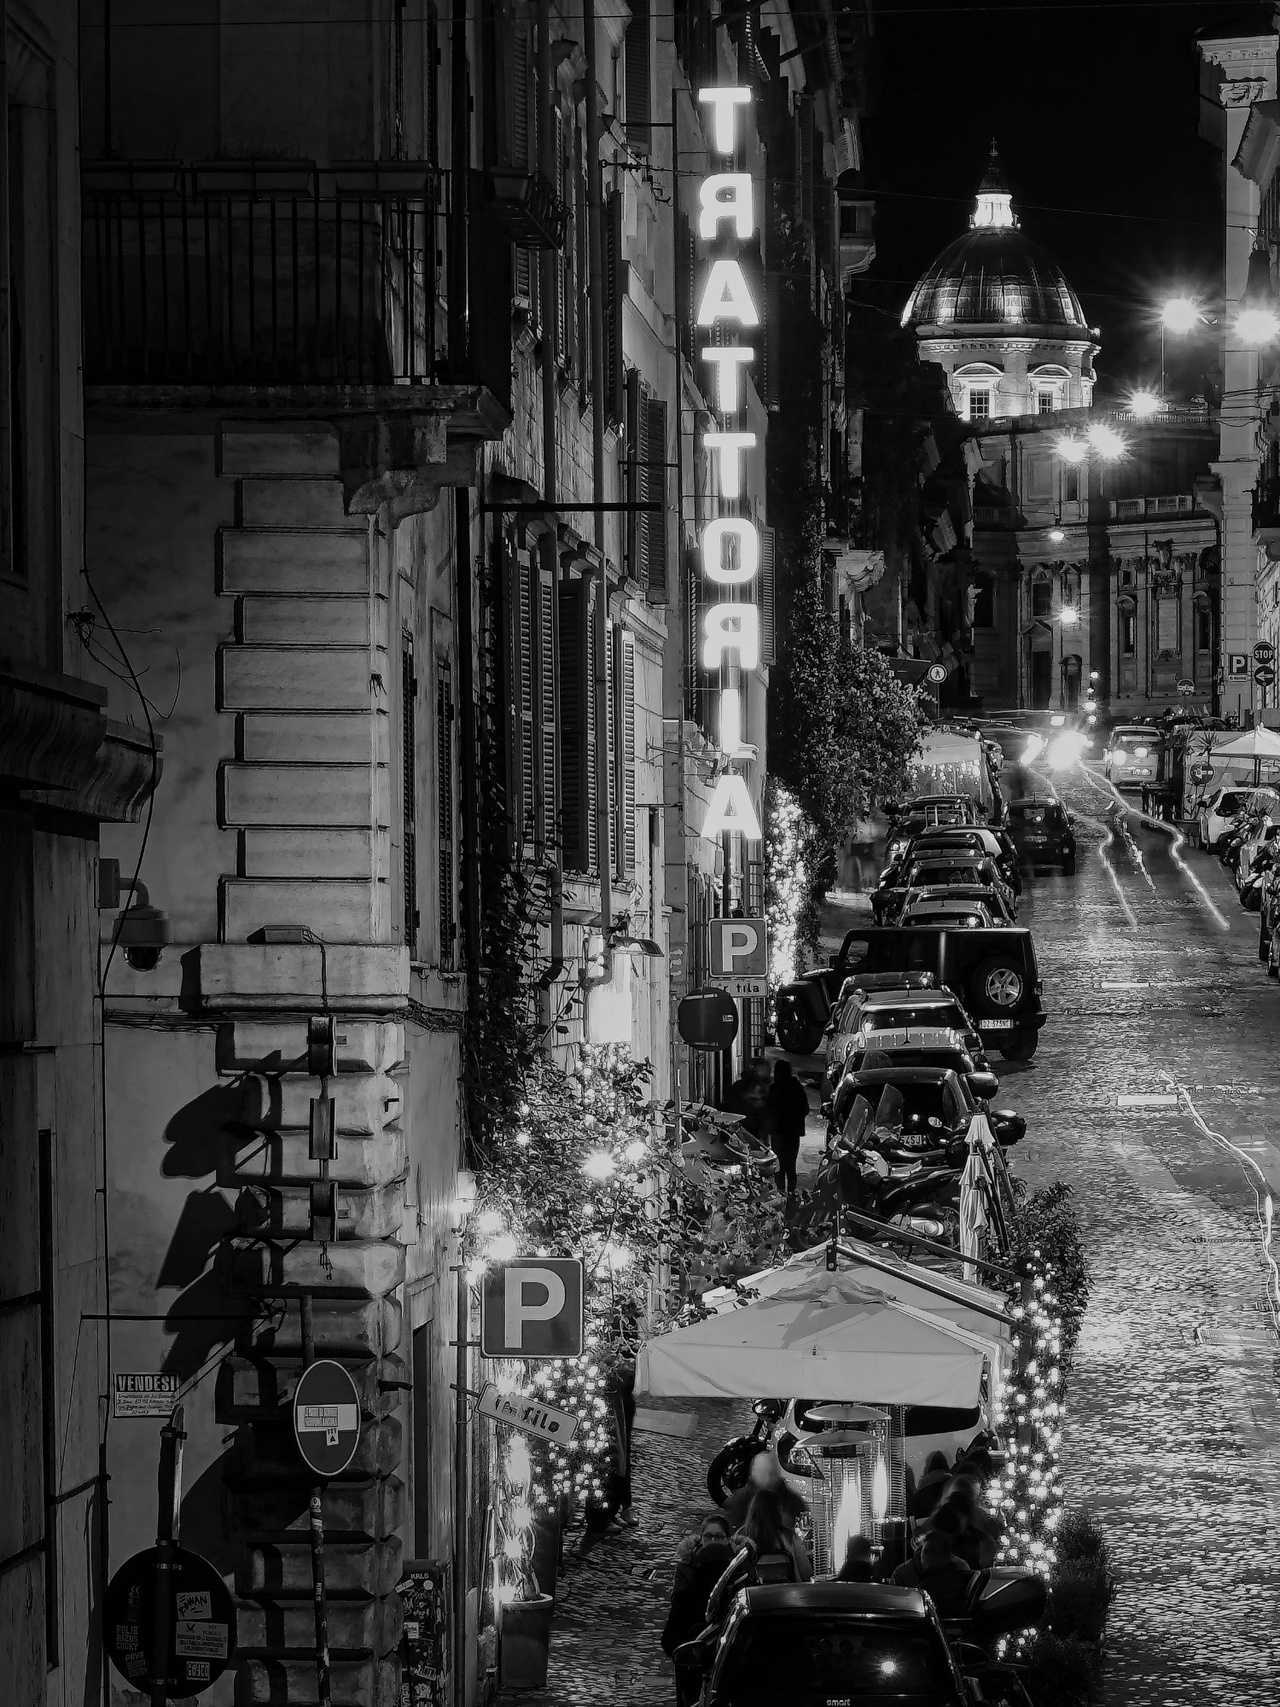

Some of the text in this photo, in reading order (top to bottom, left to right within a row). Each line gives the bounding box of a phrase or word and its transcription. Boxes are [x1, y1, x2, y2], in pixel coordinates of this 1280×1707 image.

[1254, 649, 1273, 659] STOP
[1232, 656, 1246, 673] P
[722, 924, 758, 972] P
[504, 1267, 566, 1349] P
[117, 1375, 175, 1392] VENDESI
[826, 1698, 851, 1707] smart
